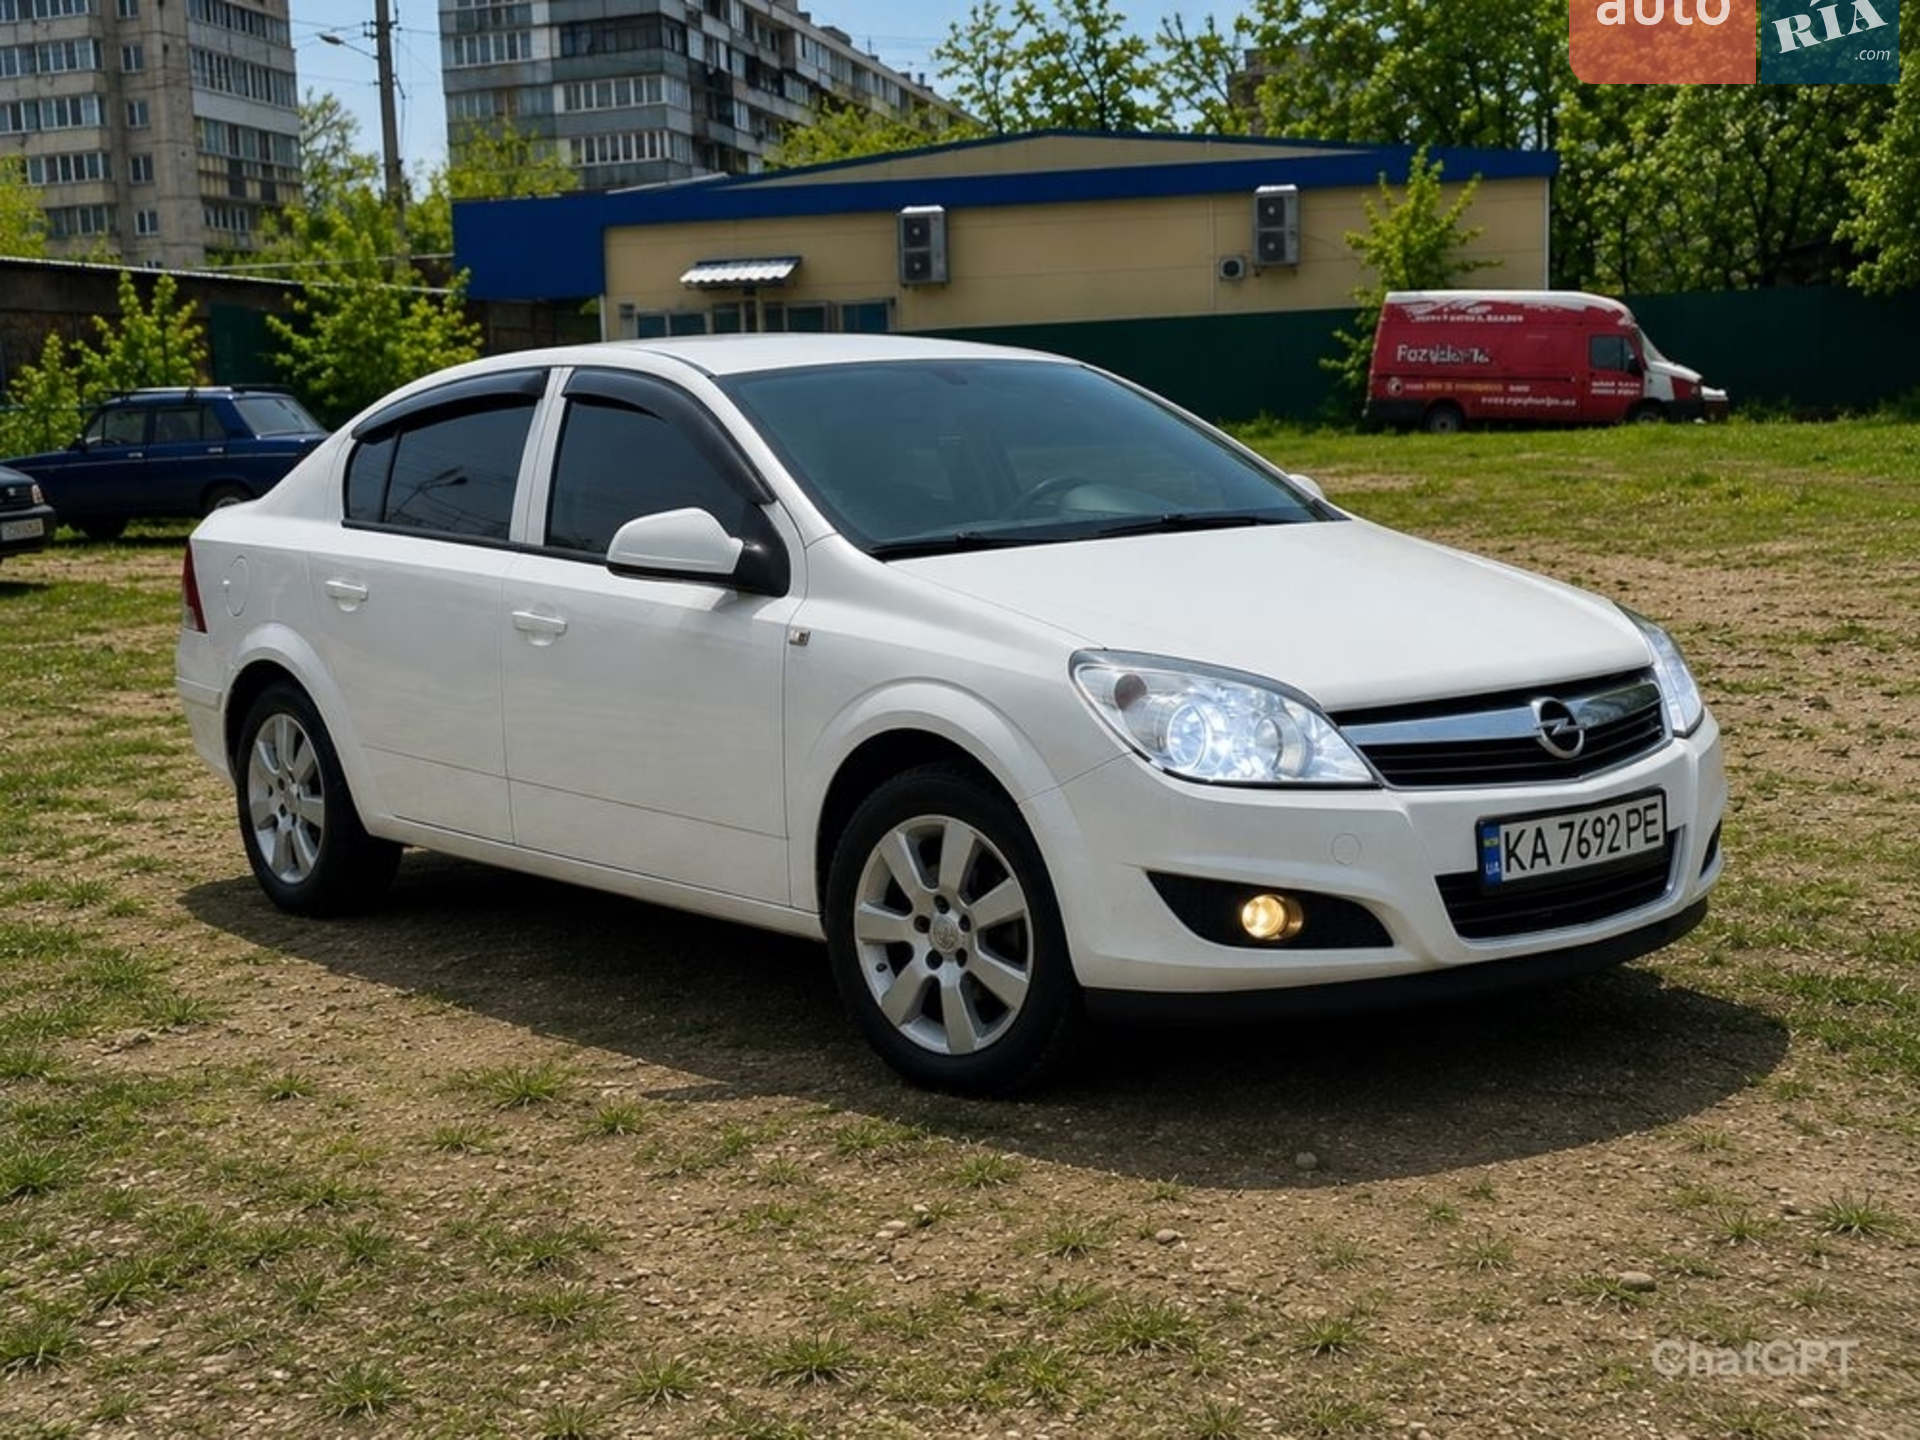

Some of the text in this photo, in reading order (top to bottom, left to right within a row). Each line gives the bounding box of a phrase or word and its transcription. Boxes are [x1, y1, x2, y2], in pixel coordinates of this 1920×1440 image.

[1504, 803, 1660, 873] KA 7692 PE
[1485, 861, 1500, 875] UA
